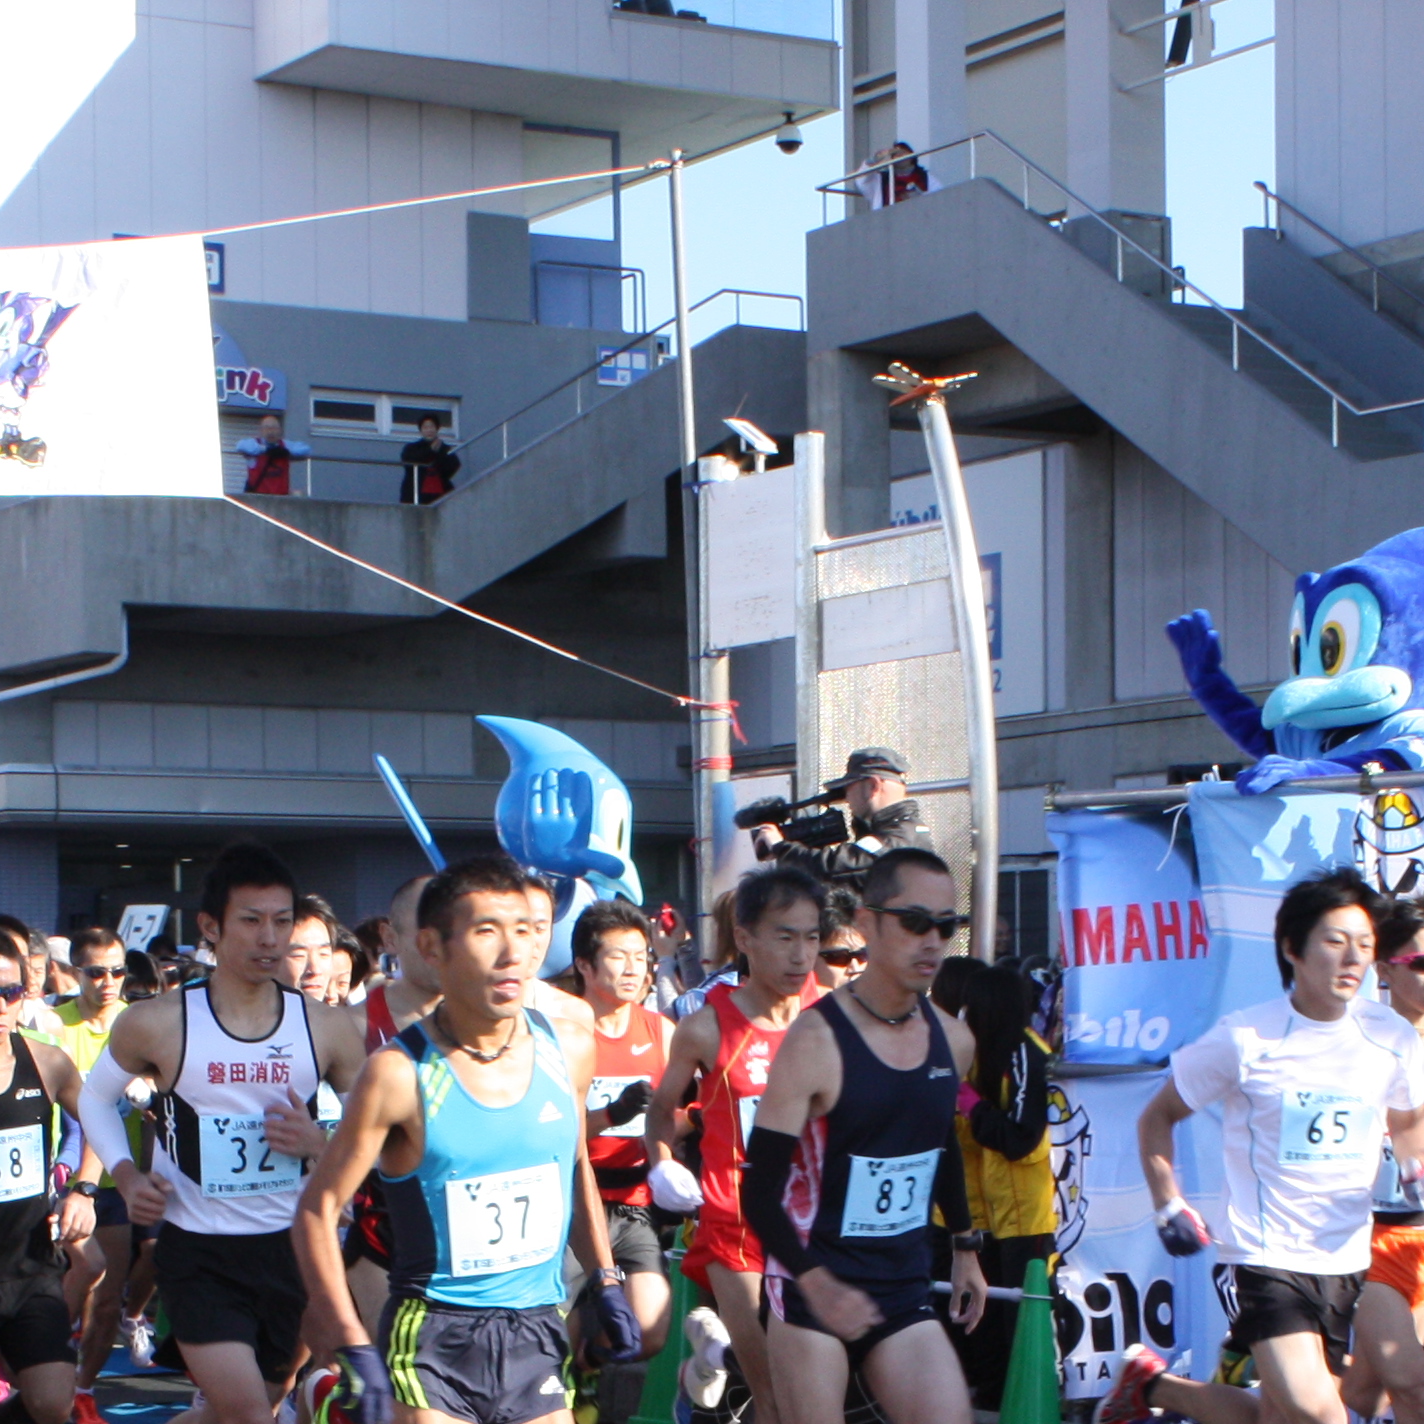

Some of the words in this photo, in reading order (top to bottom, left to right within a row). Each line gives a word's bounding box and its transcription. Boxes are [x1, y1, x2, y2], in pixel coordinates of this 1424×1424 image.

[1059, 898, 1210, 969] MAHA
[207, 1060, 291, 1085] 磐田消防
[1306, 1111, 1351, 1145] 65
[230, 1136, 276, 1174] 32
[876, 1175, 917, 1215] 83
[485, 1194, 531, 1246] 37
